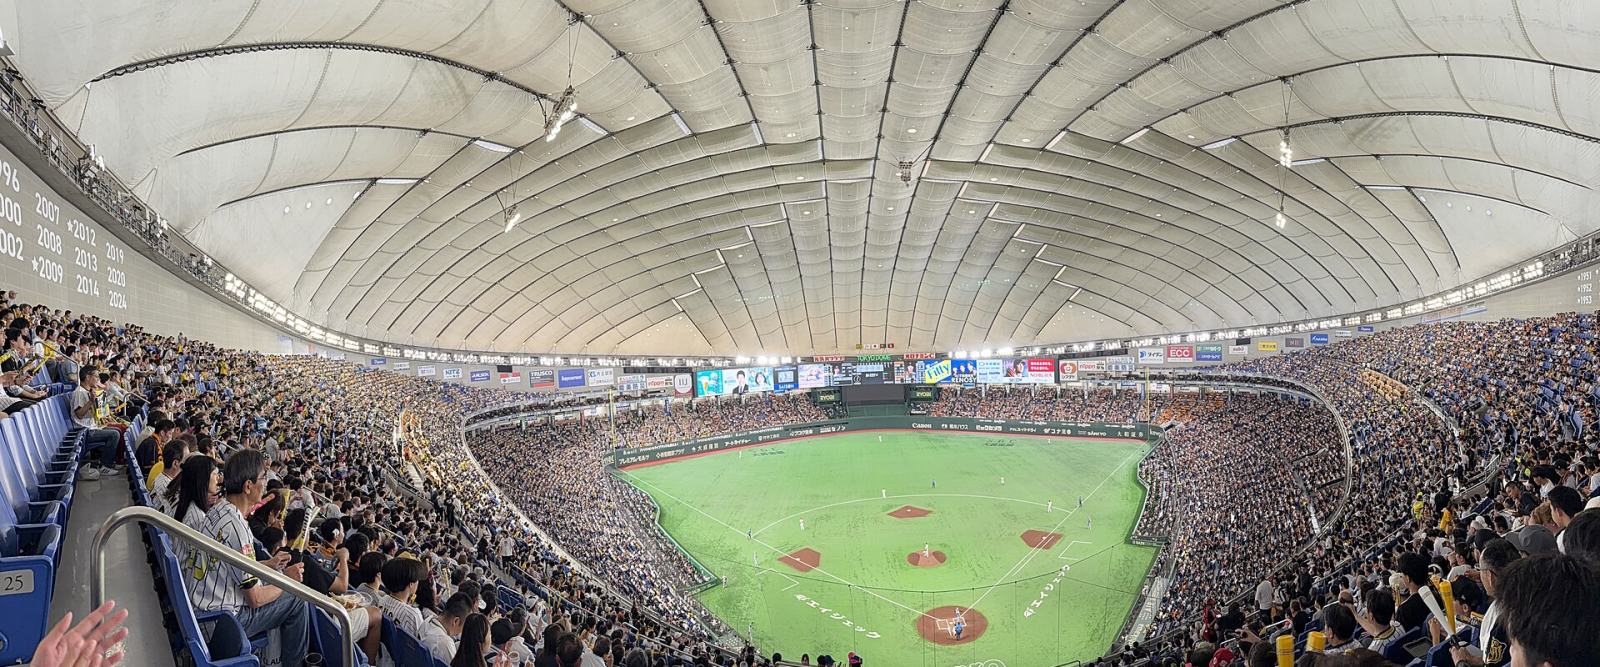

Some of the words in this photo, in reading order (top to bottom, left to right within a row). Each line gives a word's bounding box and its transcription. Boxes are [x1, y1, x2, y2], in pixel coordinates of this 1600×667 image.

[35, 192, 60, 225] 2007
[37, 224, 62, 256] 2008
[73, 220, 96, 247] 2012
[75, 246, 98, 273] 2013
[106, 242, 124, 265] 2019
[38, 256, 63, 286] 2009
[107, 267, 126, 288] 2020
[76, 275, 99, 298] 2014
[108, 290, 127, 311] 2024
[1580, 295, 1592, 304] 1953
[678, 378, 688, 386] IIJ
[4, 574, 24, 592] 25
